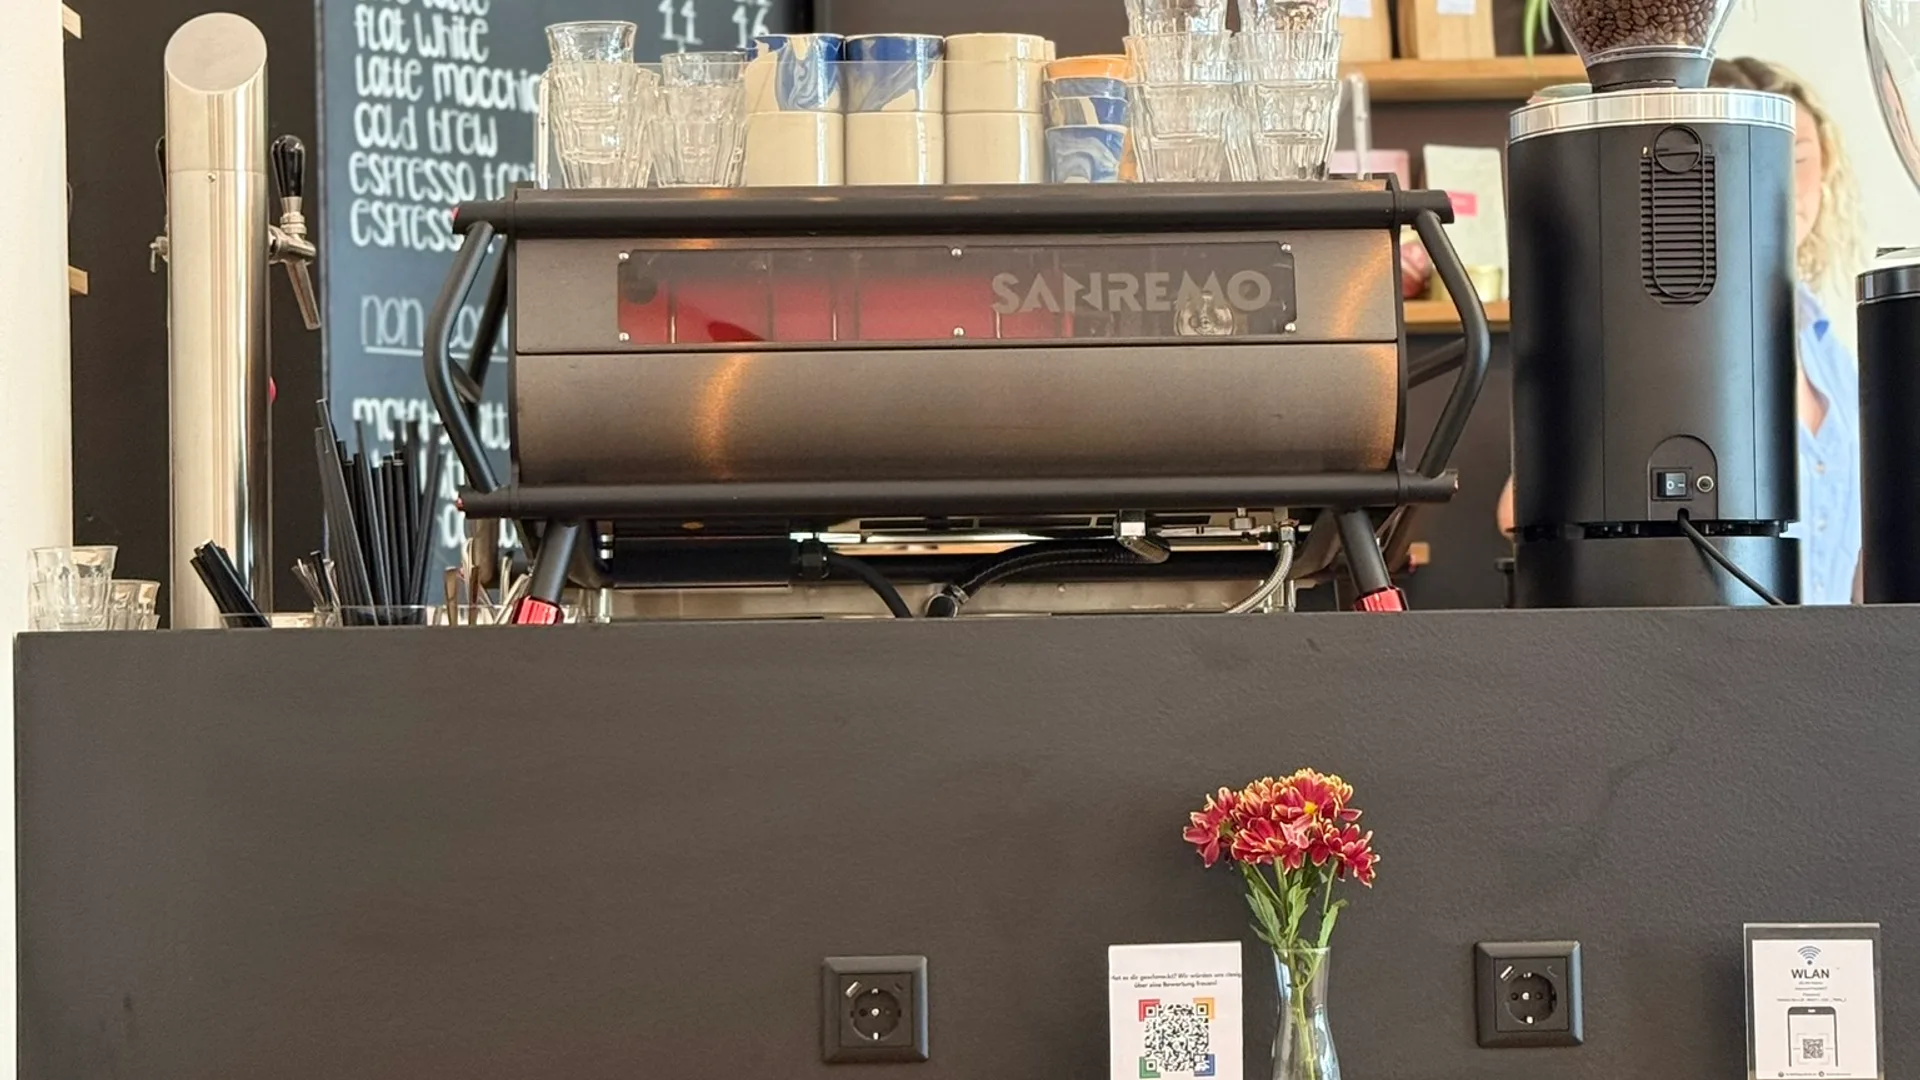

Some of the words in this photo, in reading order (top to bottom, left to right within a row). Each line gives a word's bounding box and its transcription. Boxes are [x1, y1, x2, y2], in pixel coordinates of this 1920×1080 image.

[354, 4, 410, 54] flat
[413, 12, 489, 63] white
[355, 54, 424, 101] latte
[354, 101, 418, 150] cold
[427, 106, 498, 157] brew
[348, 151, 477, 204] espresso
[350, 198, 465, 251] espress
[990, 269, 1272, 313] SANREMO
[361, 295, 425, 349] non
[1791, 969, 1830, 979] WLAN
